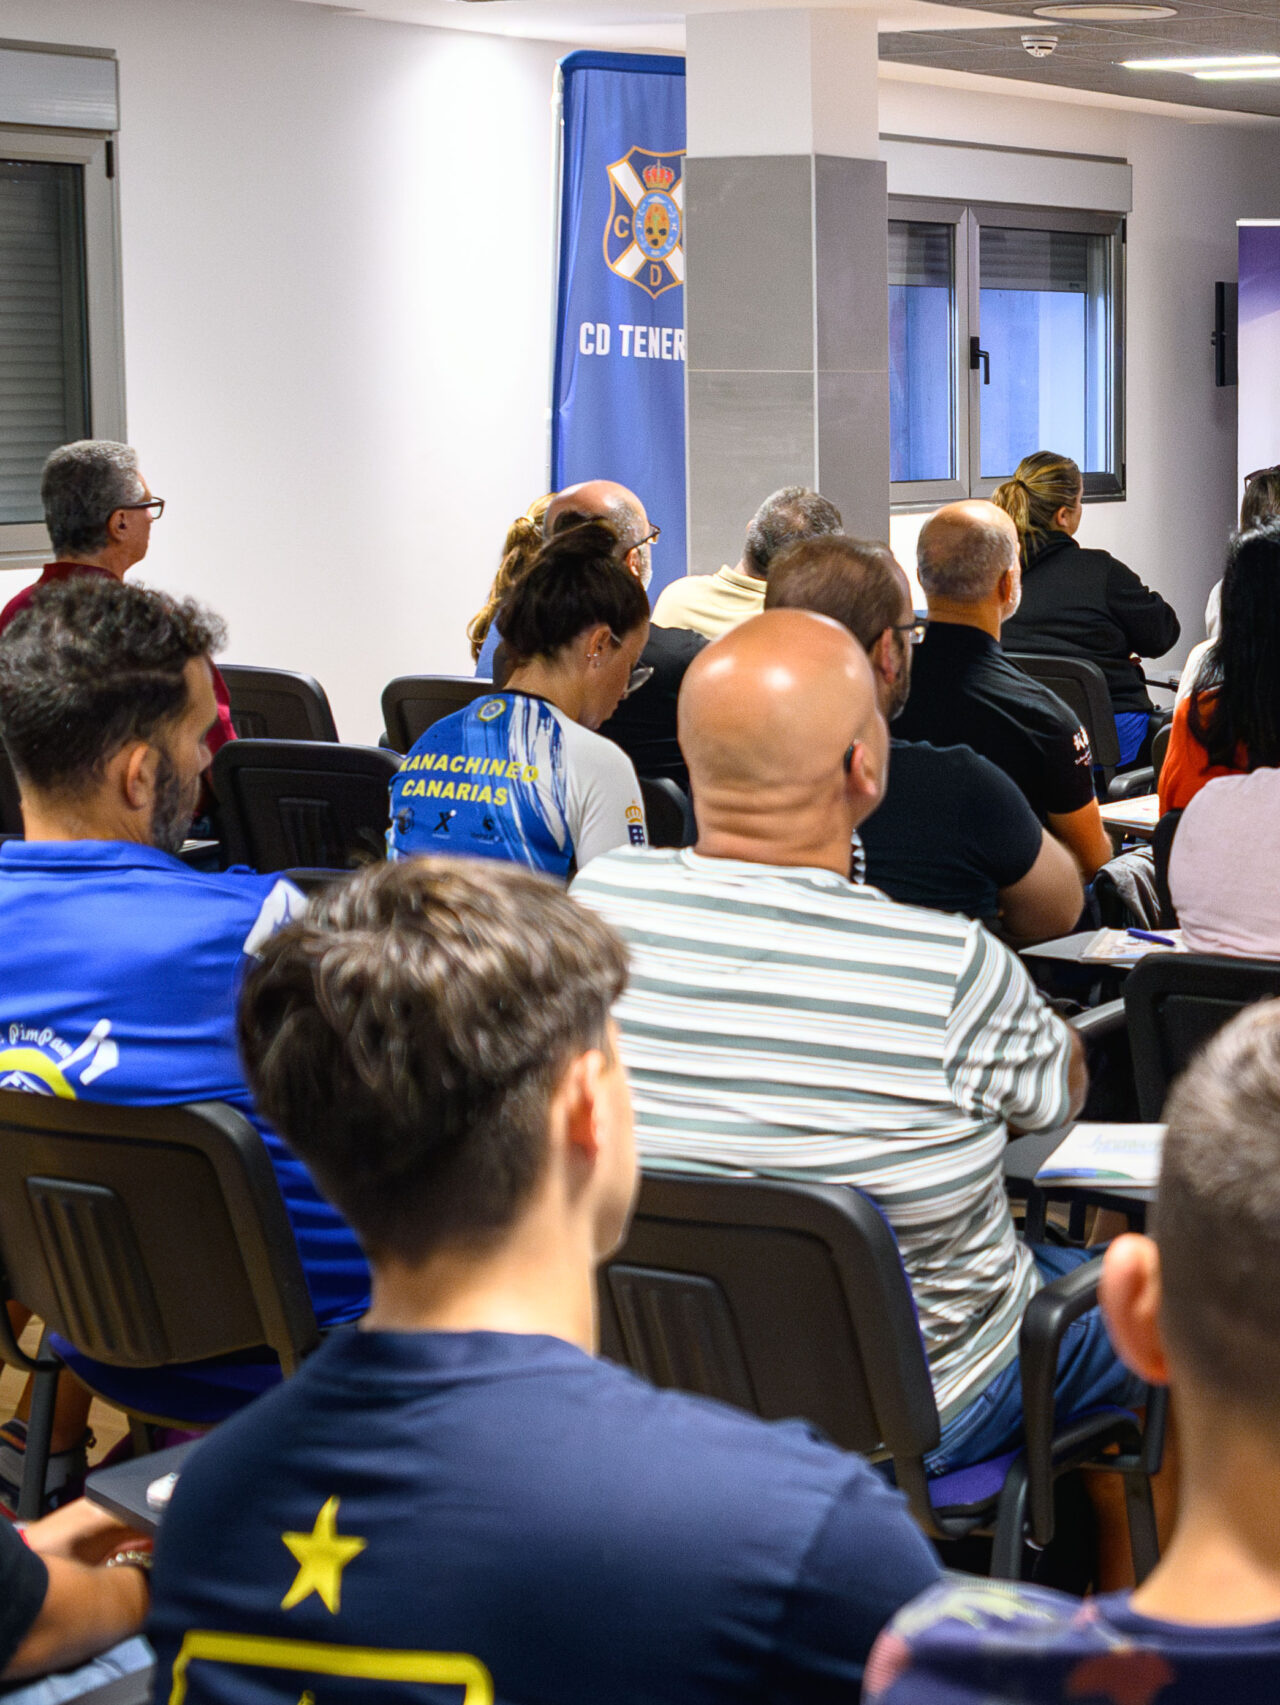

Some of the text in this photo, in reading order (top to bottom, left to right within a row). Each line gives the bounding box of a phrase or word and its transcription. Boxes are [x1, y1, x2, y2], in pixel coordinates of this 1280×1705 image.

[579, 321, 686, 361] CD TENER
[401, 779, 509, 806] CANARIAS
